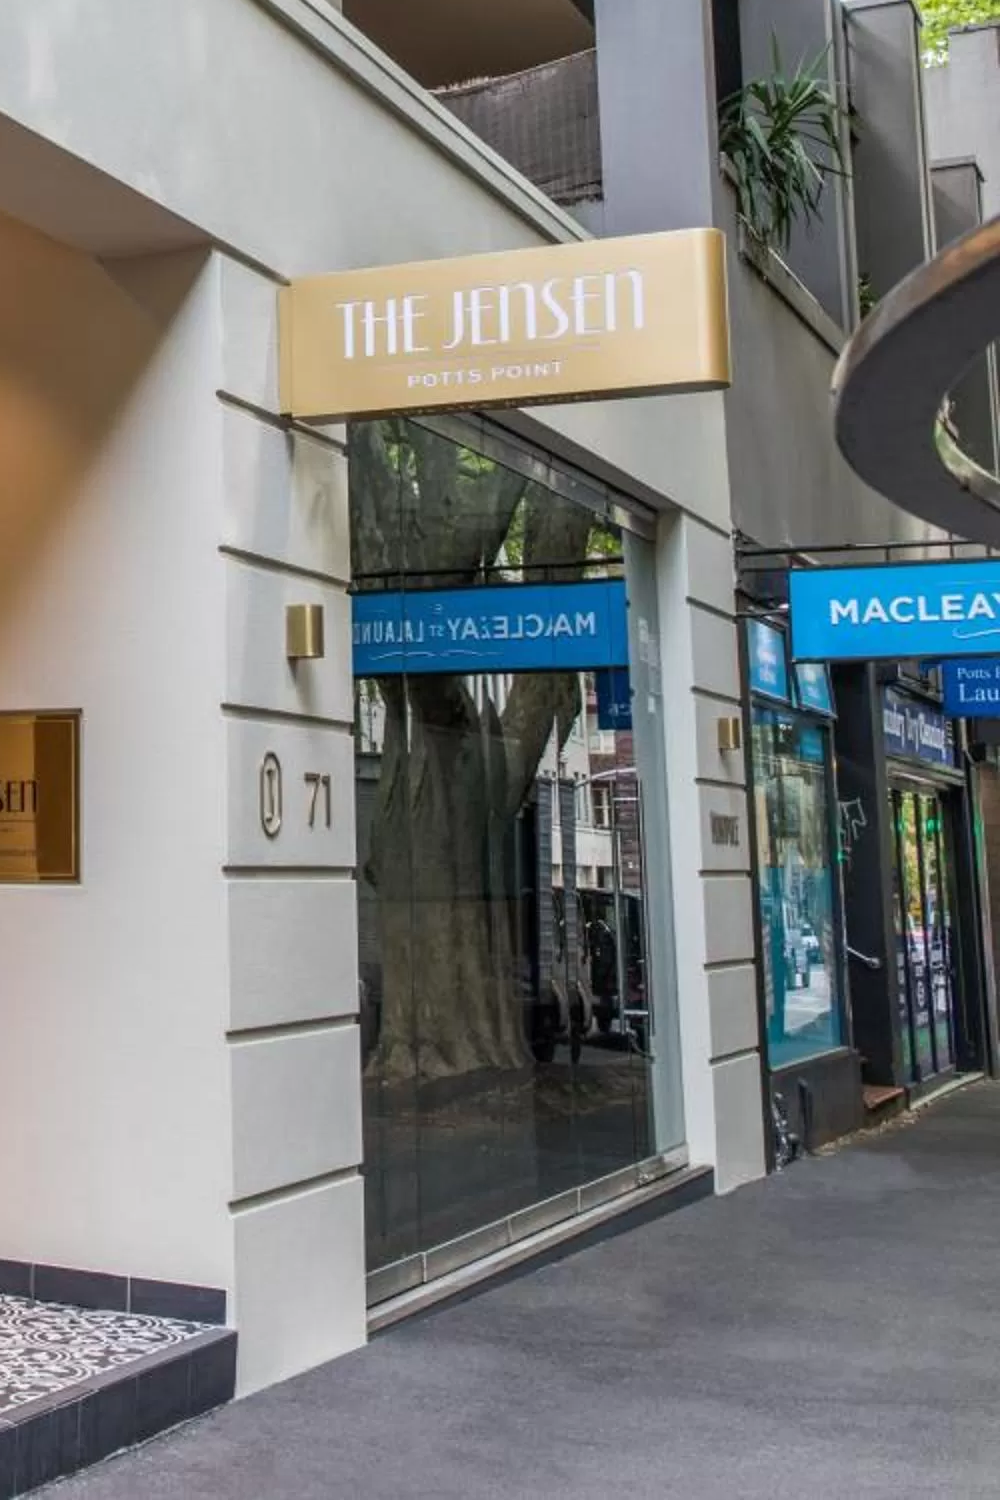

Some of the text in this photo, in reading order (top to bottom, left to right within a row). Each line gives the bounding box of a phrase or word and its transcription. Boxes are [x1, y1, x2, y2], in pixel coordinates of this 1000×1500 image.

[335, 267, 645, 359] THE JENSEN
[407, 361, 563, 389] POTTS POINT
[957, 667, 991, 680] Potts
[304, 772, 332, 829] 71
